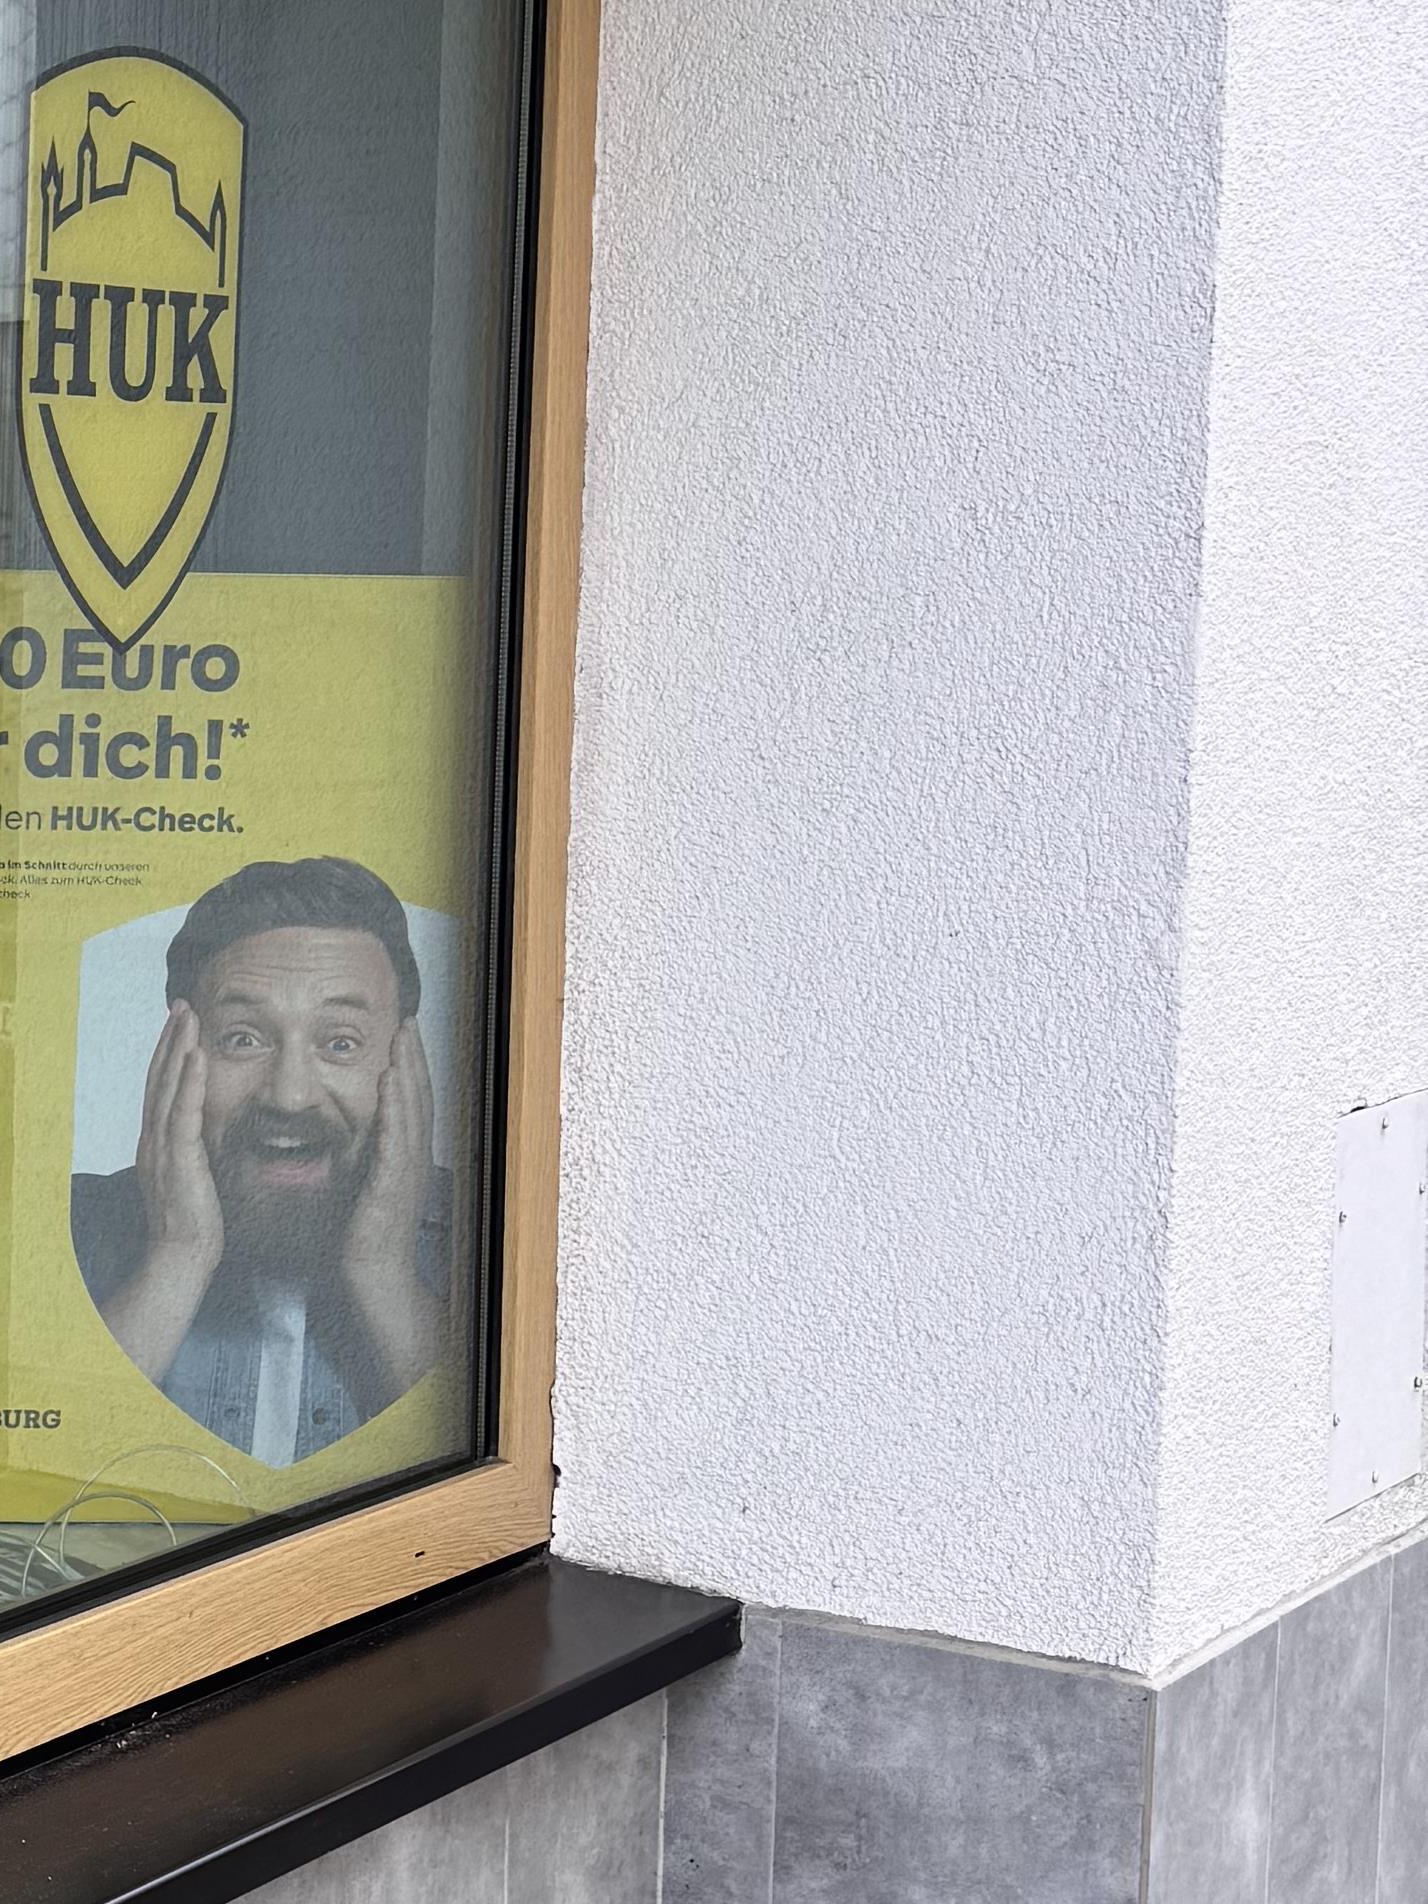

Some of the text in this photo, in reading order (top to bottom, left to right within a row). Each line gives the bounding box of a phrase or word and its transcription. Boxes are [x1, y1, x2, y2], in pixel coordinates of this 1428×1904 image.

[30, 278, 229, 403] HUK
[61, 628, 241, 693] Euro
[50, 806, 245, 834] HUK-Check.
[24, 860, 67, 871] Schnitt
